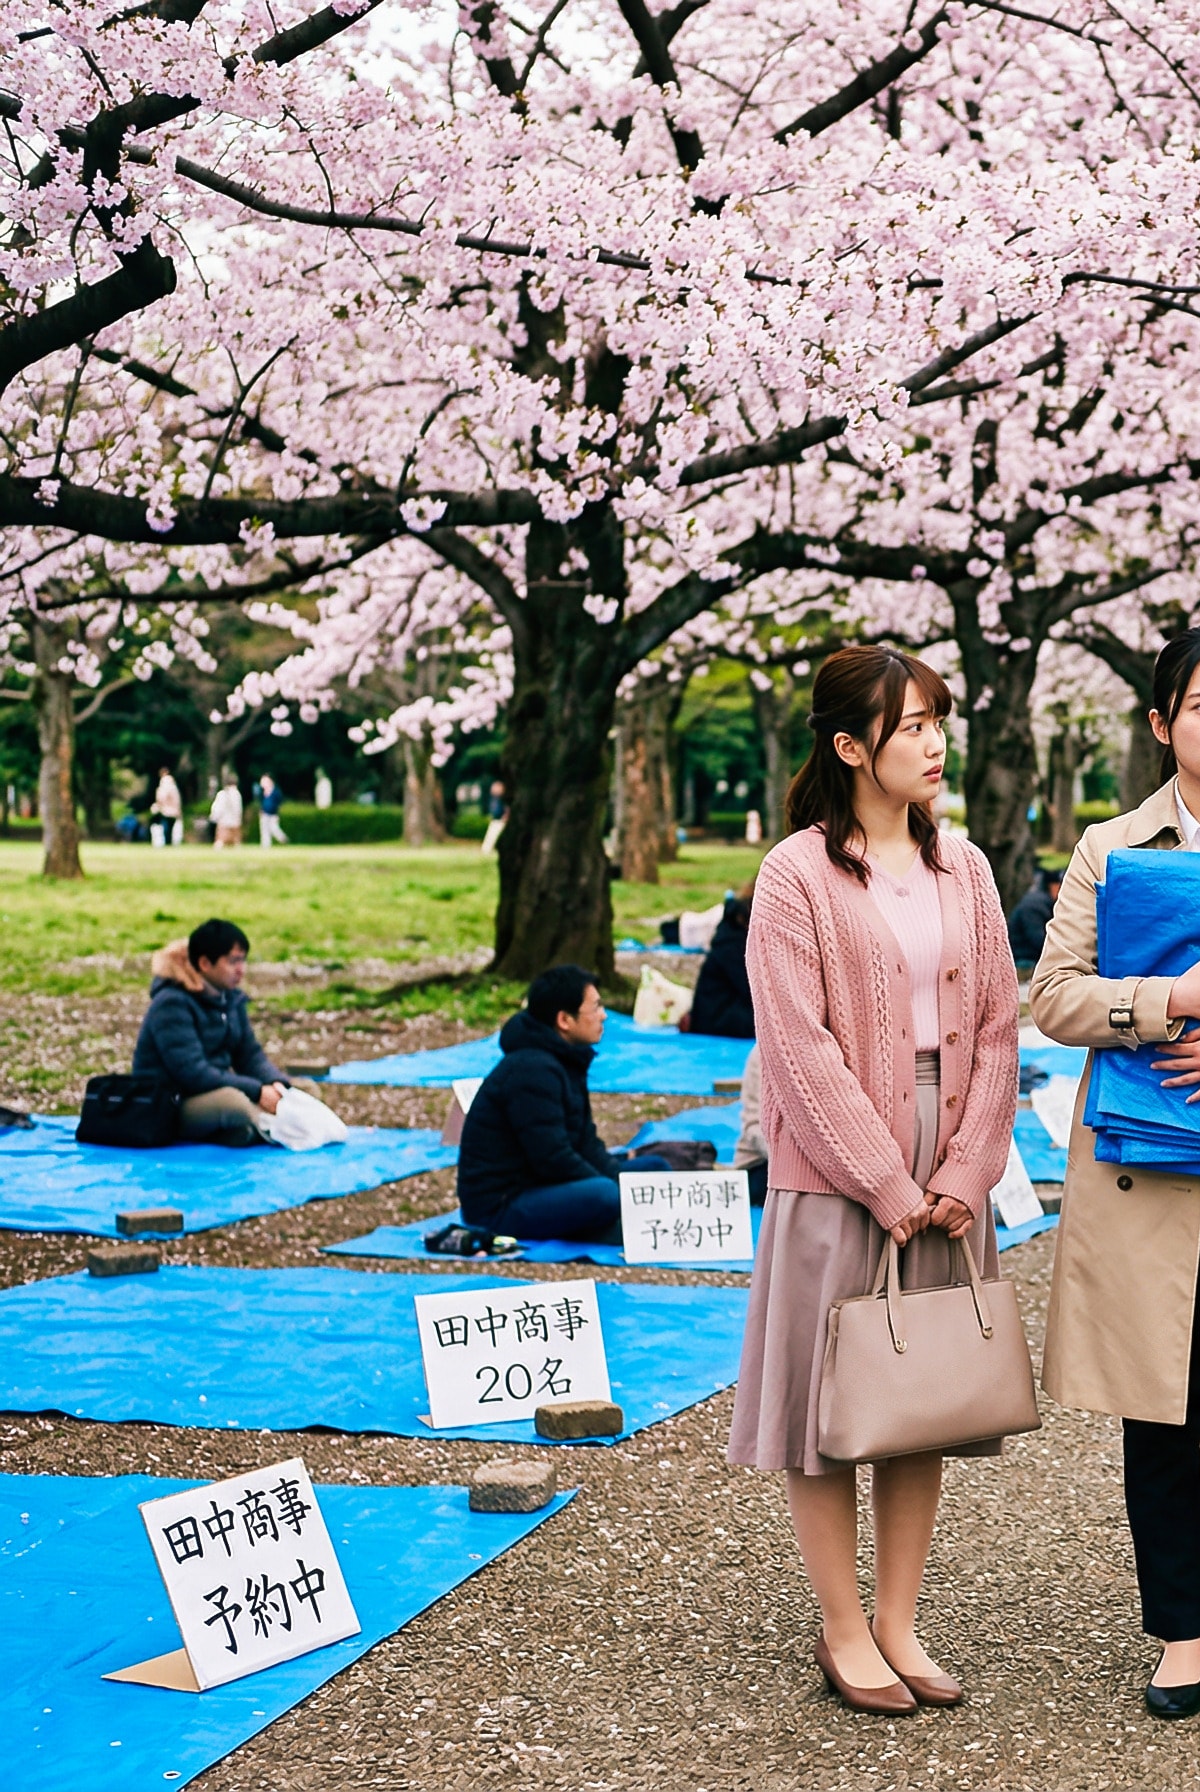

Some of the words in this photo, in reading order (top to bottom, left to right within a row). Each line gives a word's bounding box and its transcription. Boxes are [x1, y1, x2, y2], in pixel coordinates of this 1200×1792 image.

[641, 1217, 733, 1250] 予約中
[433, 1297, 589, 1348] 田中商事
[475, 1357, 571, 1404] 20名
[162, 1478, 312, 1564] 田中商事
[203, 1559, 325, 1655] 予約中
